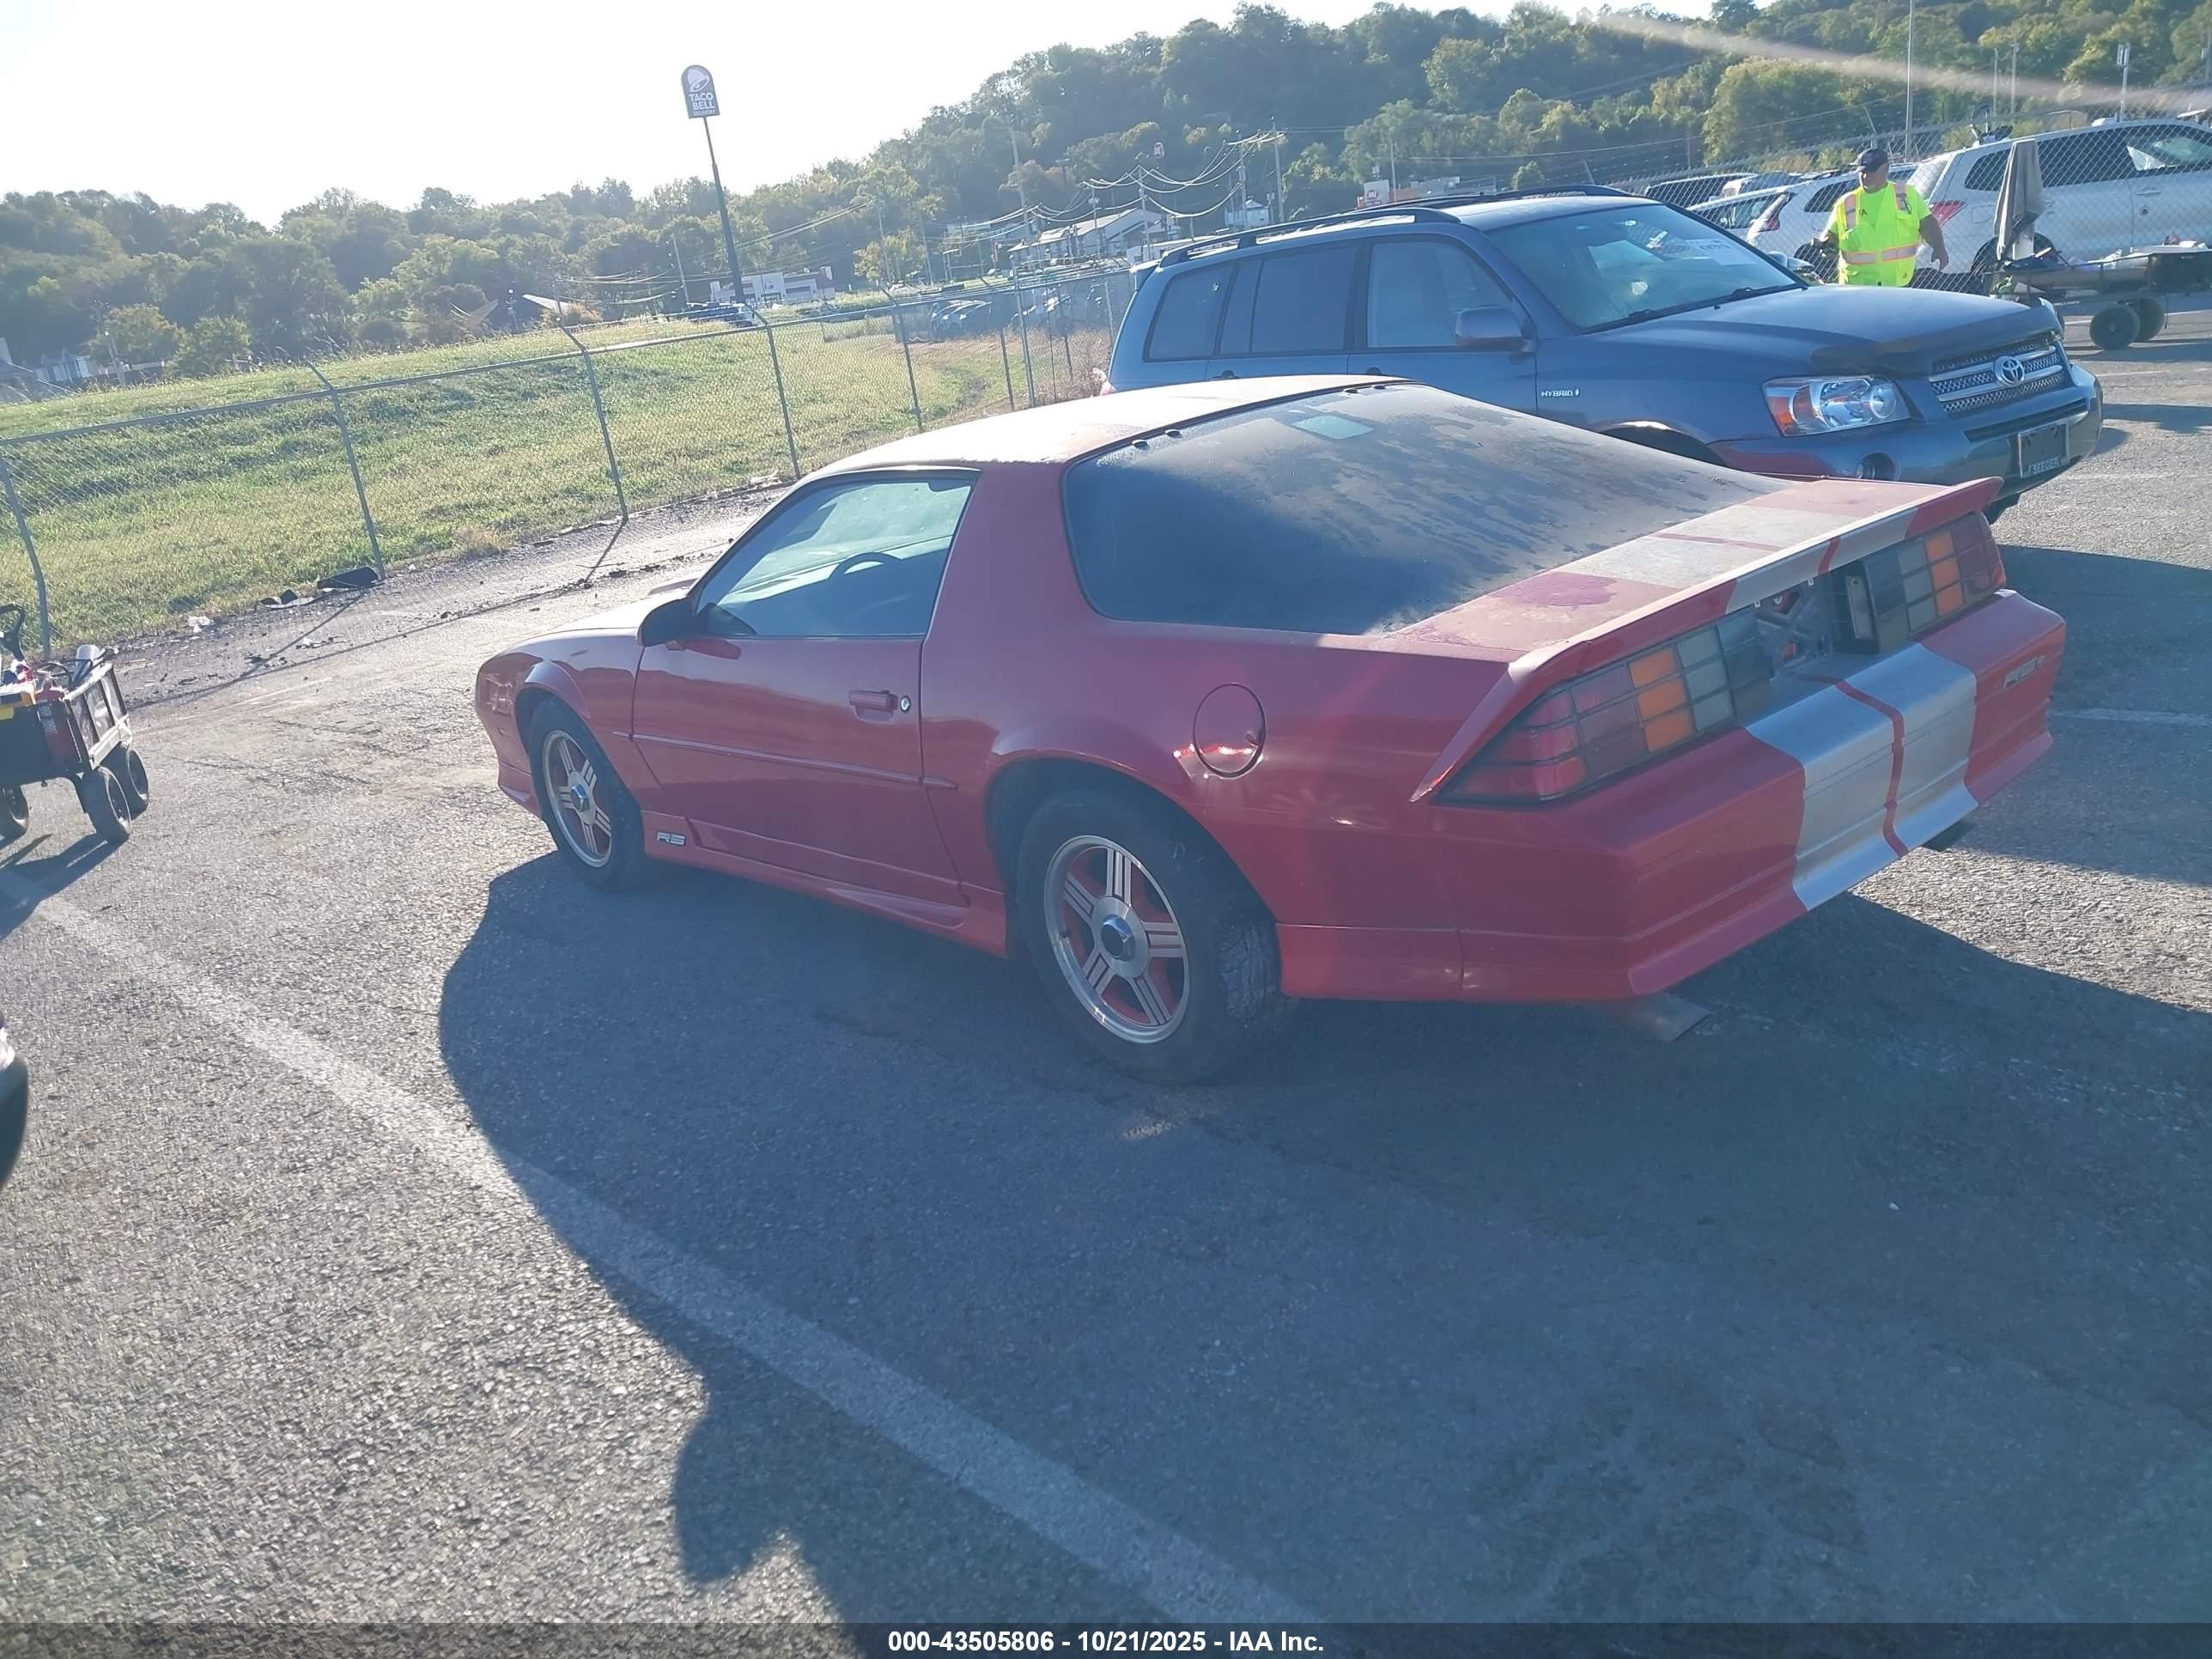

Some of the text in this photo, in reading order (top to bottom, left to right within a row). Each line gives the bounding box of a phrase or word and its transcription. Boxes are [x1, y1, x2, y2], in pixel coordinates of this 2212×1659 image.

[689, 92, 714, 102] TACO
[693, 100, 715, 110] BELL
[657, 832, 685, 846] RS
